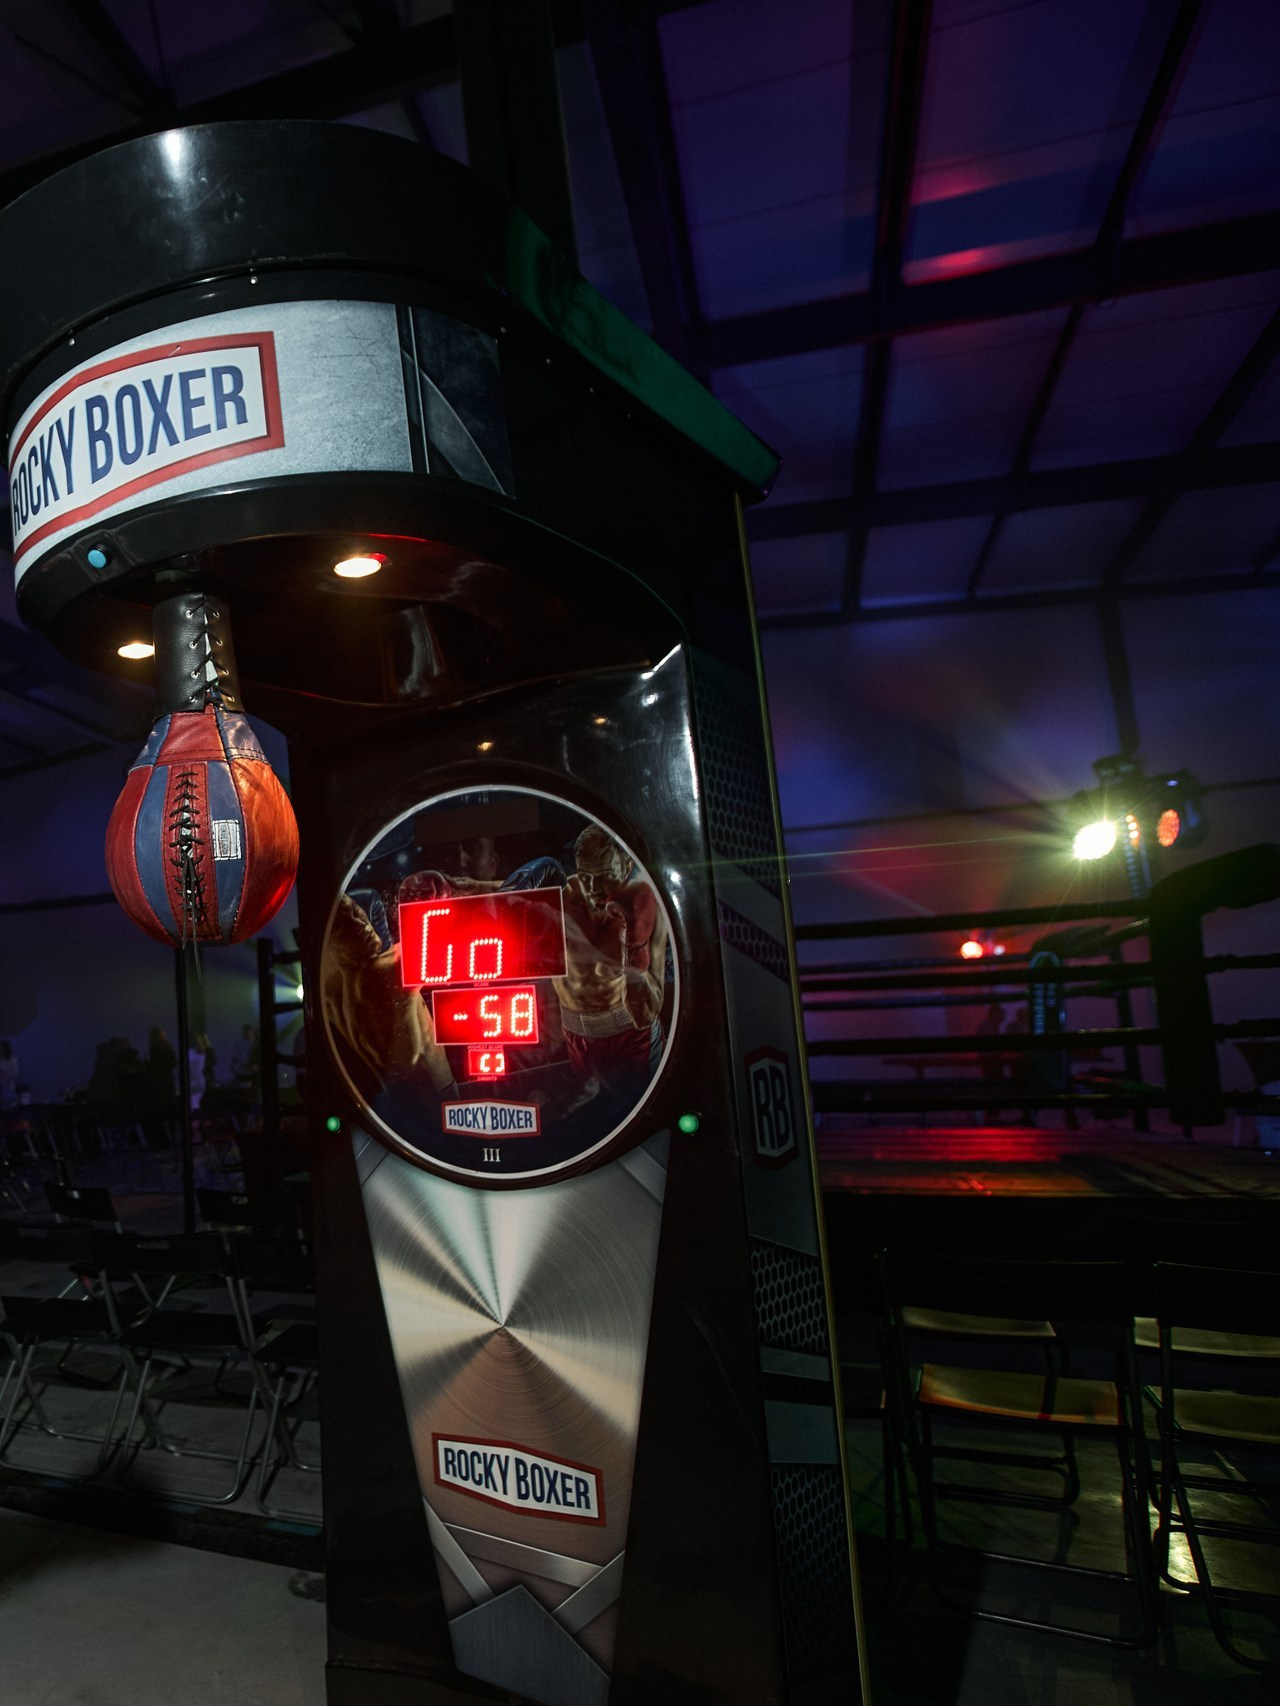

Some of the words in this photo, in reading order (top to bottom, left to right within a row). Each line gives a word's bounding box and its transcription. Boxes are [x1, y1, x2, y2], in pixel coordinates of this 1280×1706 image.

[12, 406, 75, 535] ROCKY
[85, 365, 248, 484] BOXER
[448, 1106, 487, 1130] ROCKY
[491, 1106, 533, 1130] BOXER
[444, 1447, 509, 1496] ROCKY
[515, 1457, 591, 1509] BOXER
